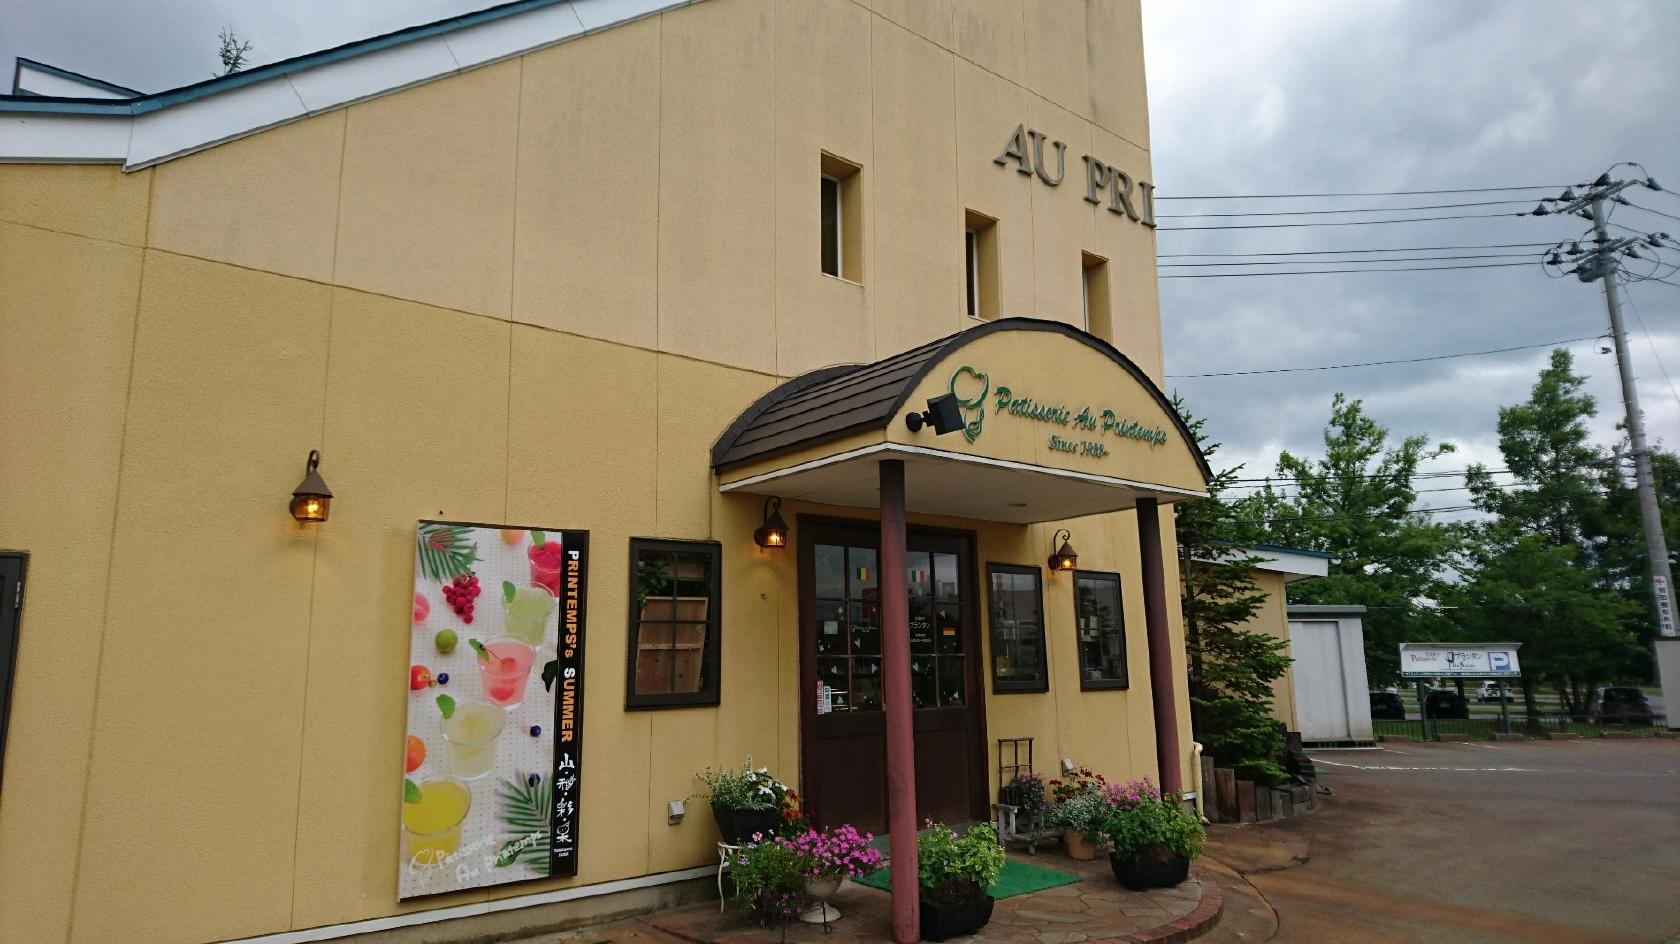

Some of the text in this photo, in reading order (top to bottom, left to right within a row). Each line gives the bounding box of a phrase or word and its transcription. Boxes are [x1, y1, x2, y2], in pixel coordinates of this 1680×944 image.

[993, 123, 1157, 229] AU PRI
[994, 386, 1168, 447] Patisserie Au Printemps
[1049, 435, 1079, 455] Since
[1489, 653, 1509, 671] P
[561, 667, 577, 743] SUMMER
